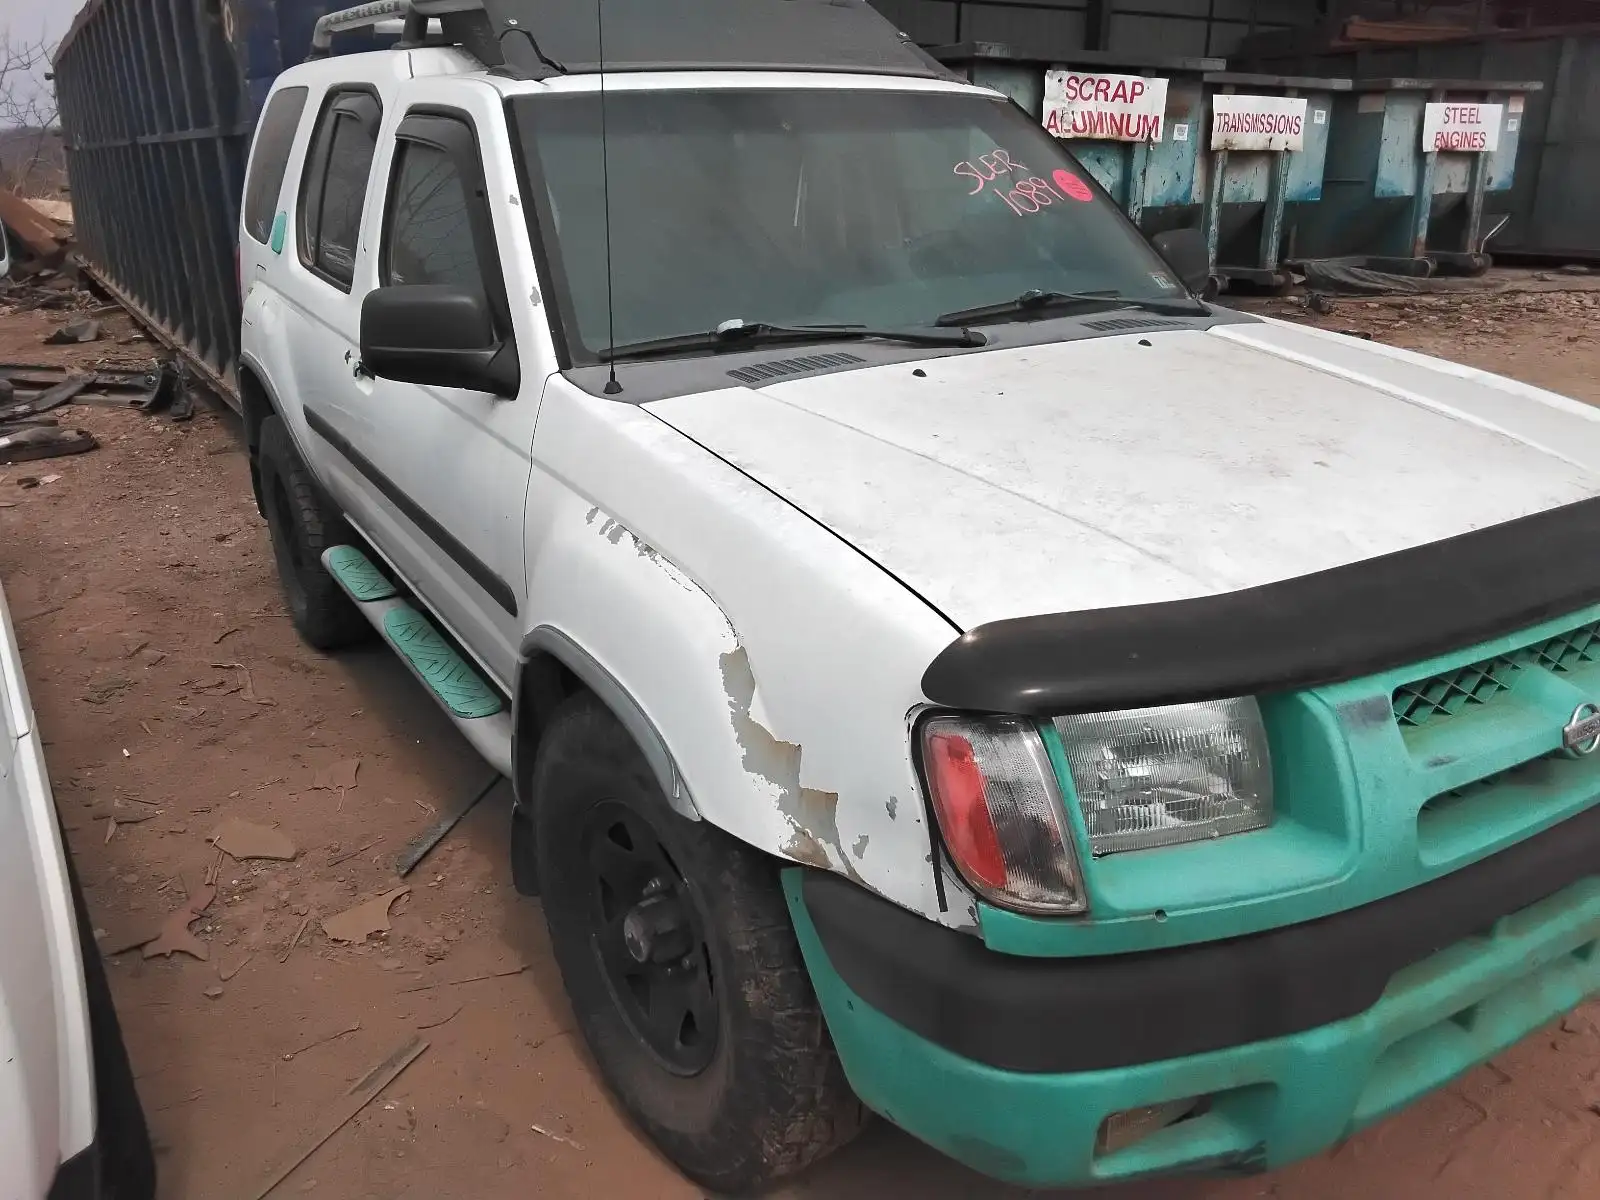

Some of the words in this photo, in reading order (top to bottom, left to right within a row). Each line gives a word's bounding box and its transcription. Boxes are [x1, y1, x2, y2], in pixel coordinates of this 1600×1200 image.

[1065, 75, 1145, 104] SCRAP
[1046, 109, 1160, 139] ALUMINUM
[1216, 112, 1302, 136] TRANSMISSIONS
[1443, 106, 1482, 124] STEEL
[1434, 131, 1487, 149] ENGINES
[993, 176, 1065, 217] 1089
